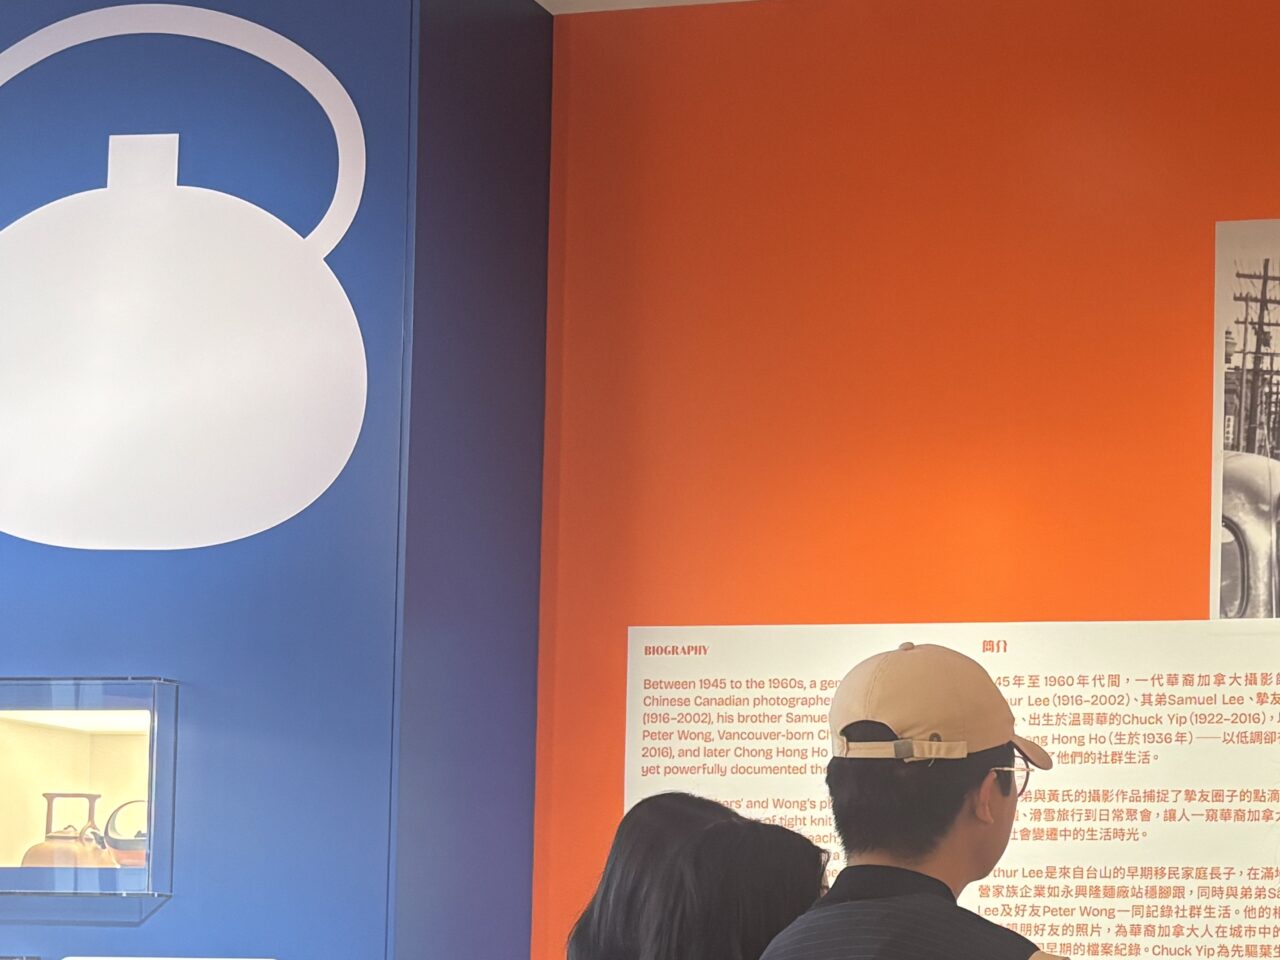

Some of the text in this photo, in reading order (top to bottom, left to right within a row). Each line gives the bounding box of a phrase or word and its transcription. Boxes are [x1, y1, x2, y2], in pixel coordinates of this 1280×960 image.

[643, 644, 710, 656] BIOGRAPHY
[643, 678, 696, 690] Between
[698, 678, 727, 690] 1945
[729, 679, 743, 690] to
[745, 677, 766, 690] the
[768, 677, 807, 691] 1960s,
[809, 679, 817, 689] a
[643, 695, 691, 707] Chinese
[693, 694, 750, 707] Canadian
[716, 711, 735, 724] his
[737, 711, 783, 724] brother
[785, 711, 828, 724] Samue
[642, 729, 675, 741] Peter
[676, 729, 715, 743] Wong,
[717, 728, 815, 741] Vancouver-born
[677, 746, 701, 758] and
[703, 746, 731, 758] later
[733, 746, 774, 761] Chong
[776, 746, 809, 761] Hong
[811, 746, 829, 759] Ho
[641, 764, 661, 777] yet
[663, 763, 728, 777] powerfully
[730, 763, 807, 775] documented
[745, 797, 769, 810] and
[810, 815, 833, 827] knit
